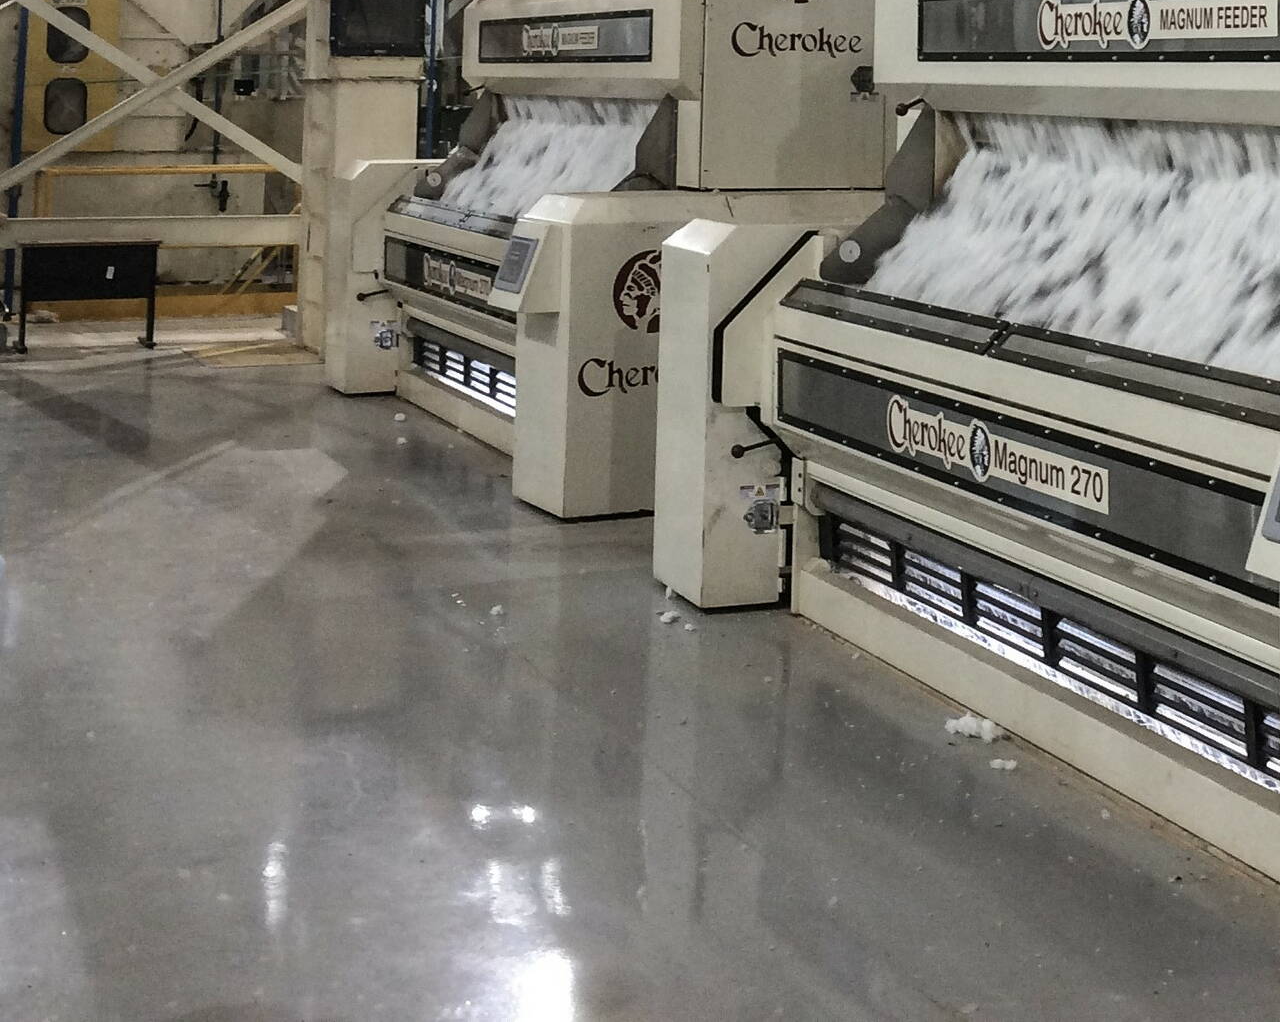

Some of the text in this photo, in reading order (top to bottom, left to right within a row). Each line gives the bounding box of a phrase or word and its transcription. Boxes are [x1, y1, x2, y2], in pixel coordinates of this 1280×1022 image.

[731, 21, 863, 59] Cherokee
[1039, 0, 1268, 46] Cherokee MAGNUM FEEDER
[577, 357, 659, 398] Cher
[888, 398, 1104, 503] Cherokee Magnum 270
